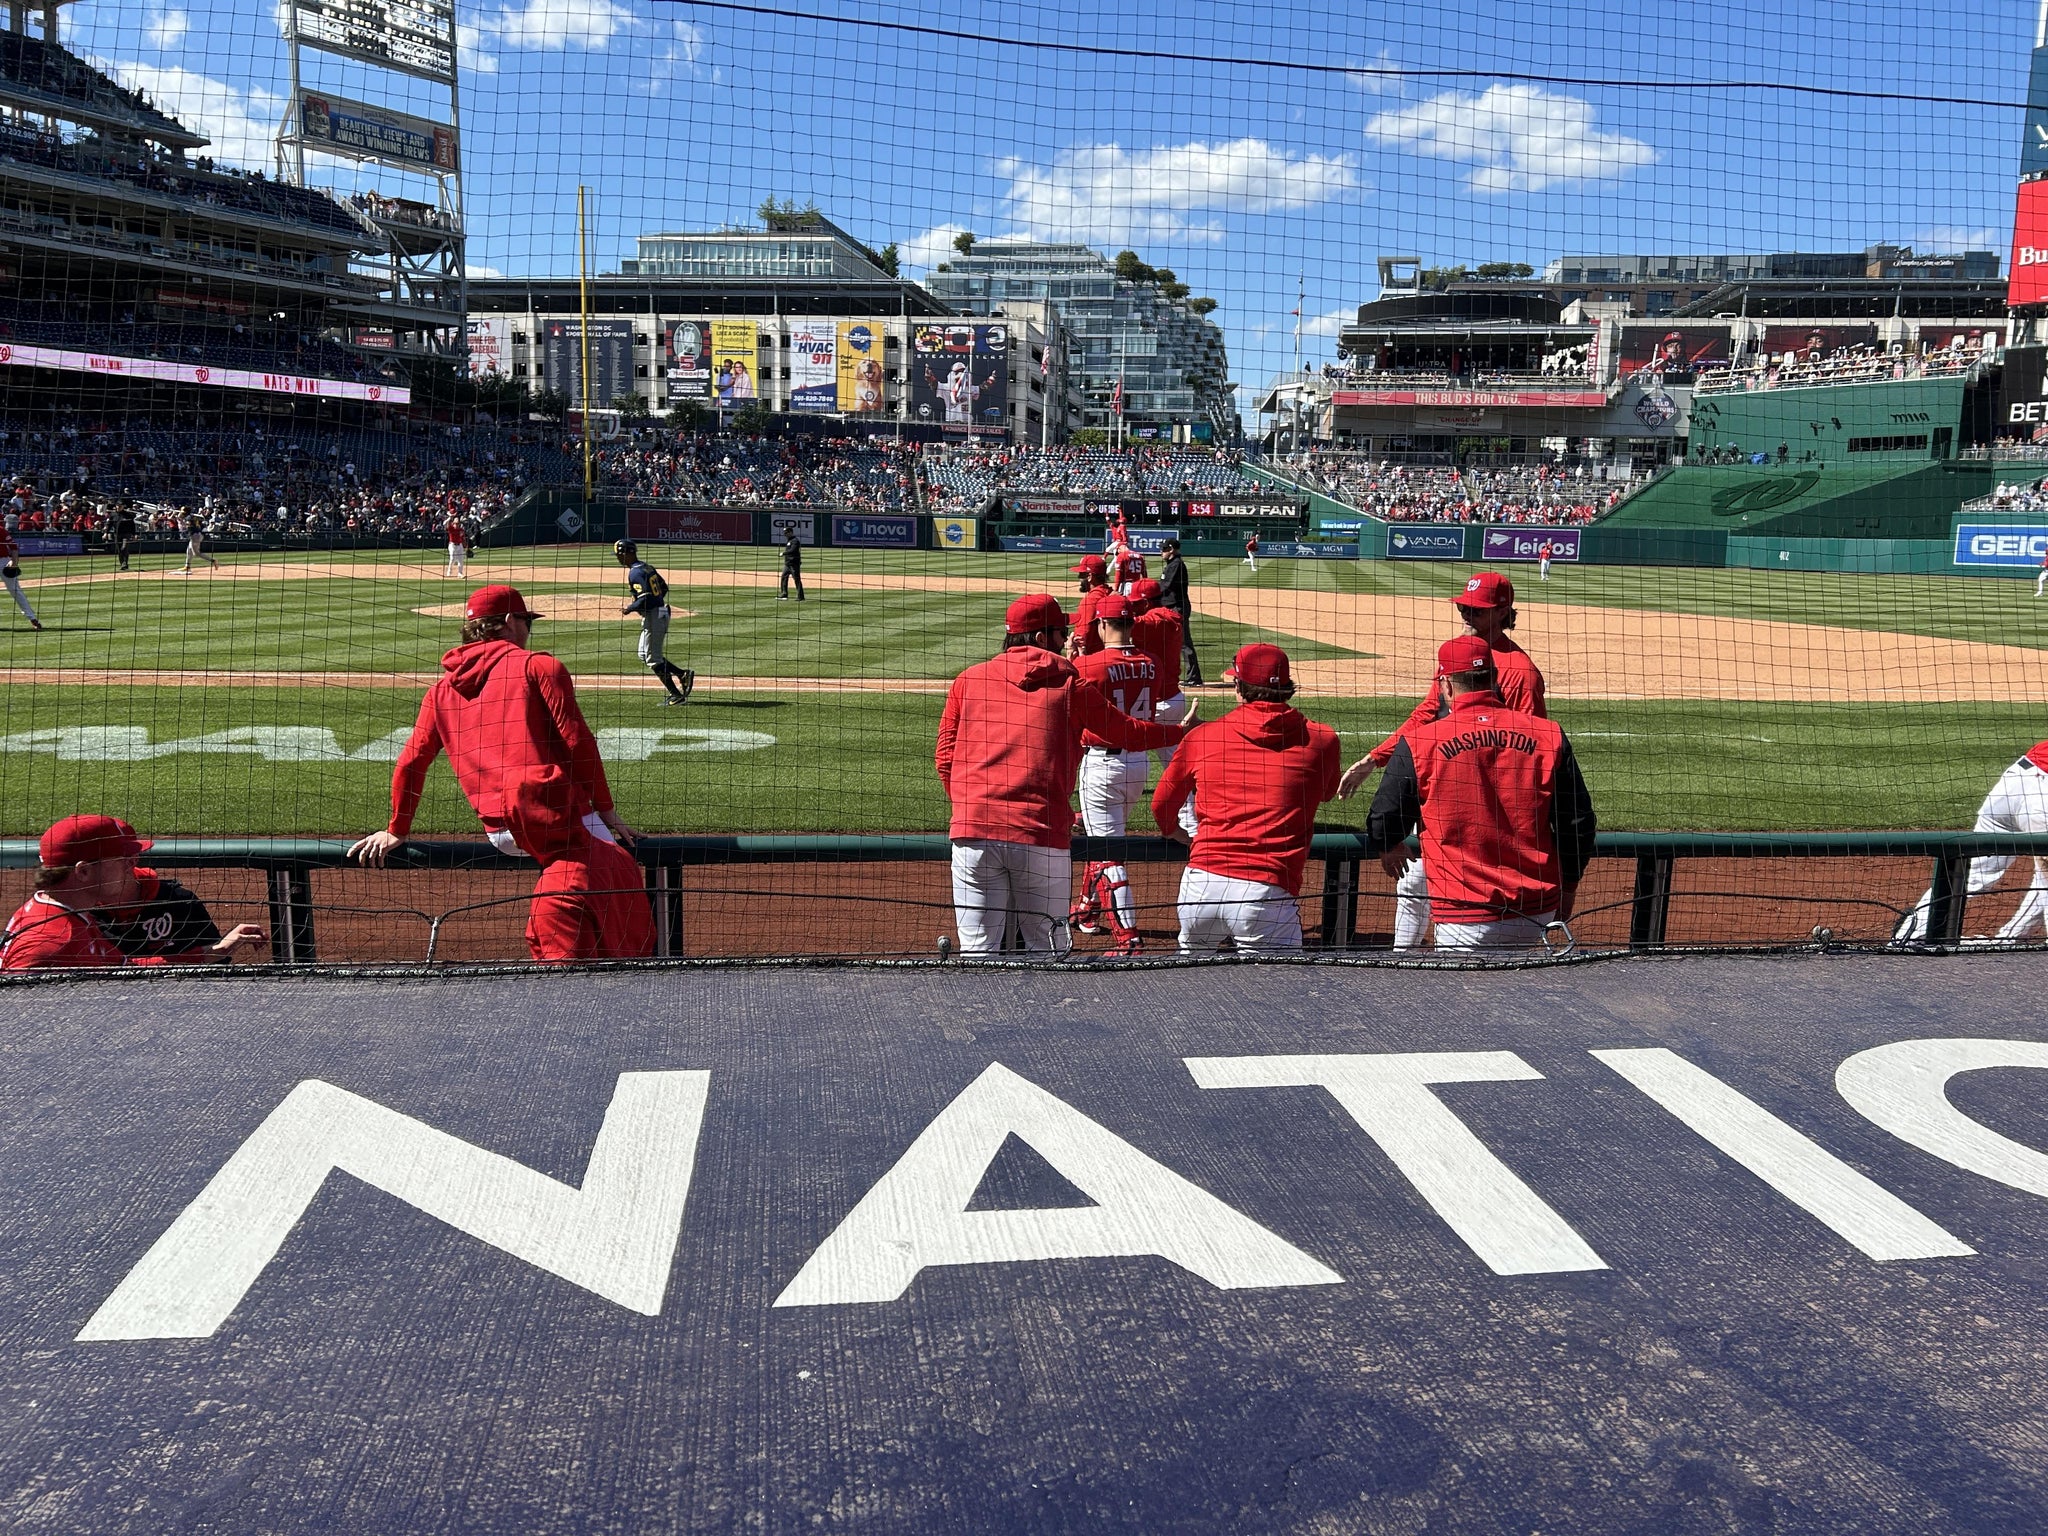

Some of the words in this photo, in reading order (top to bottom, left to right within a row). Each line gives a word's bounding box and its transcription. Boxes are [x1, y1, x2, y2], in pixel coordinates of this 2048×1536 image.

[340, 118, 381, 138] BEAUTIFUL
[383, 130, 407, 142] VIEWS
[409, 134, 426, 149] AND
[335, 130, 364, 146] AWARD
[366, 136, 402, 153] WINNING
[403, 145, 430, 160] BREWS
[484, 336, 497, 345] FOR
[798, 343, 834, 353] HVAC
[812, 354, 832, 364] 911
[264, 374, 290, 390] NATS
[295, 378, 320, 394] WIN!
[1415, 393, 1439, 404] THIS
[1440, 393, 1472, 404] BUD'S
[1474, 393, 1495, 404] FOR
[1497, 394, 1521, 404] YOU.
[1022, 502, 1050, 511] Harris
[1053, 502, 1082, 512] Teeter
[1145, 506, 1160, 515] 3.65
[1191, 503, 1211, 515] 3:54
[1259, 505, 1296, 516] FAN
[773, 519, 813, 529] GDIT
[863, 523, 907, 536] Inova
[658, 528, 722, 540] Budweiser
[1130, 535, 1168, 549] Terr
[1407, 536, 1458, 546] VANDA
[1129, 560, 1142, 573] 45
[1108, 662, 1156, 683] MILLAS
[1112, 687, 1152, 722] 14
[1438, 729, 1538, 760] WASHINGTON
